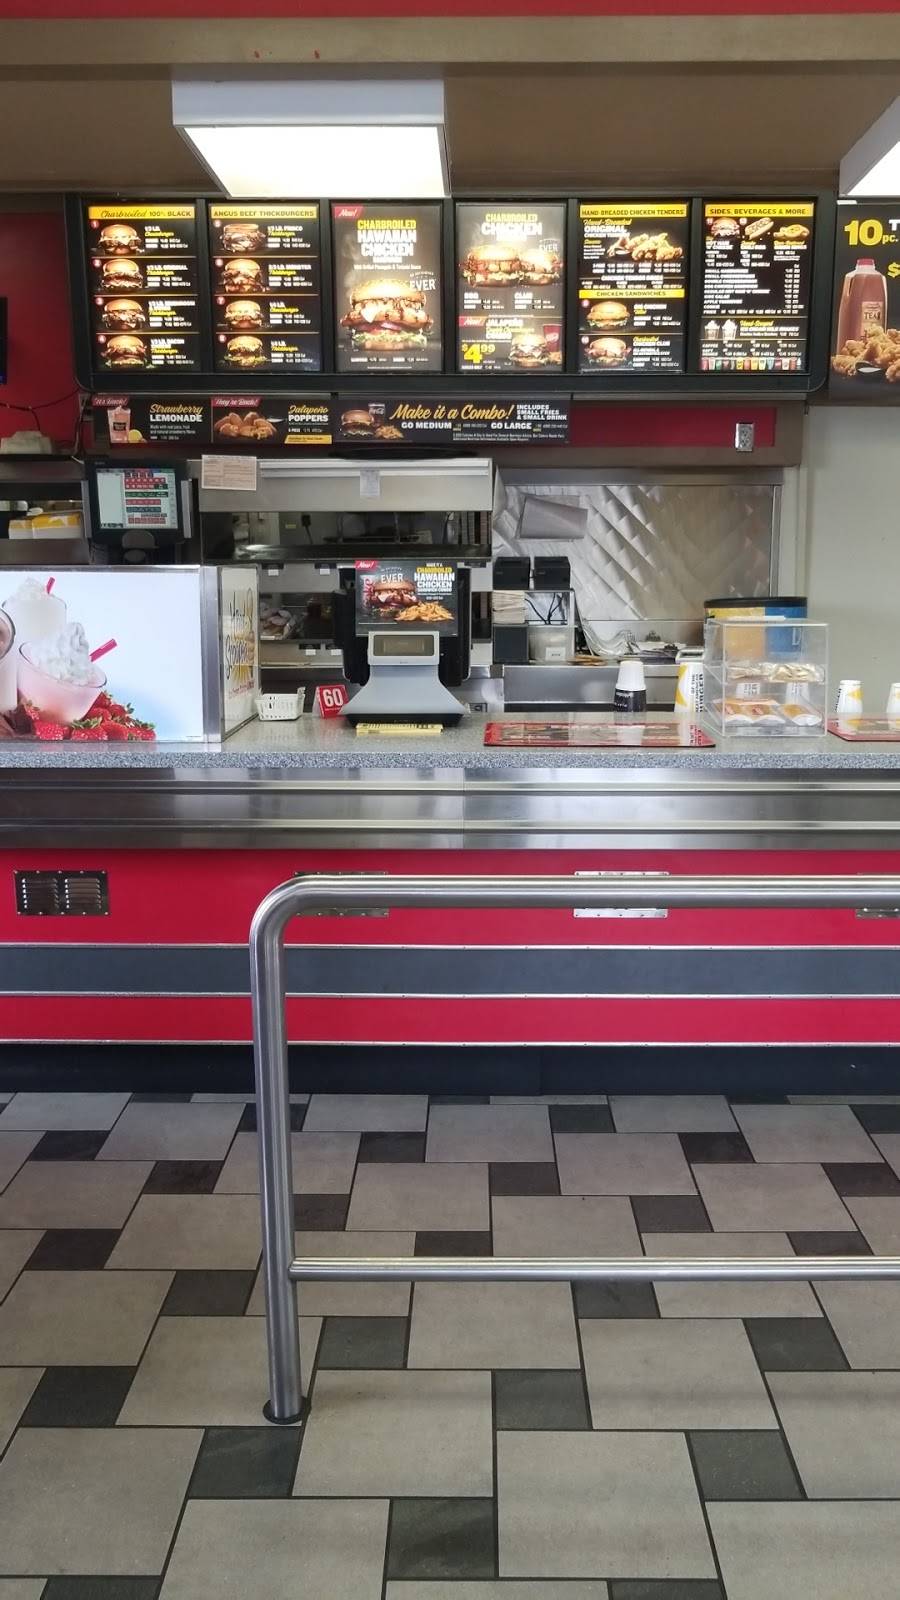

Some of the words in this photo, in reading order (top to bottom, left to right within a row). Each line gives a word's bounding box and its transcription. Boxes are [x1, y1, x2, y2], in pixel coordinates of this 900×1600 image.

[100, 209, 147, 218] Charbroiled
[485, 214, 538, 222] CHARBROILED
[358, 220, 416, 230] CHARBROILED
[481, 222, 542, 235] CHICKEN
[358, 230, 416, 243] HAWAIIAN
[844, 219, 884, 246] 10
[882, 234, 898, 244] pc.
[361, 243, 414, 256] CHICKEN
[410, 280, 436, 290] EVER
[150, 404, 203, 415] Strawberry
[288, 405, 328, 414] Jalapeño
[389, 404, 431, 420] Make
[434, 405, 445, 419] it
[447, 409, 459, 419] a
[461, 405, 515, 419] Combo!
[381, 574, 403, 583] EVER
[414, 573, 455, 581] HAWAIIAN
[323, 688, 343, 707] 60
